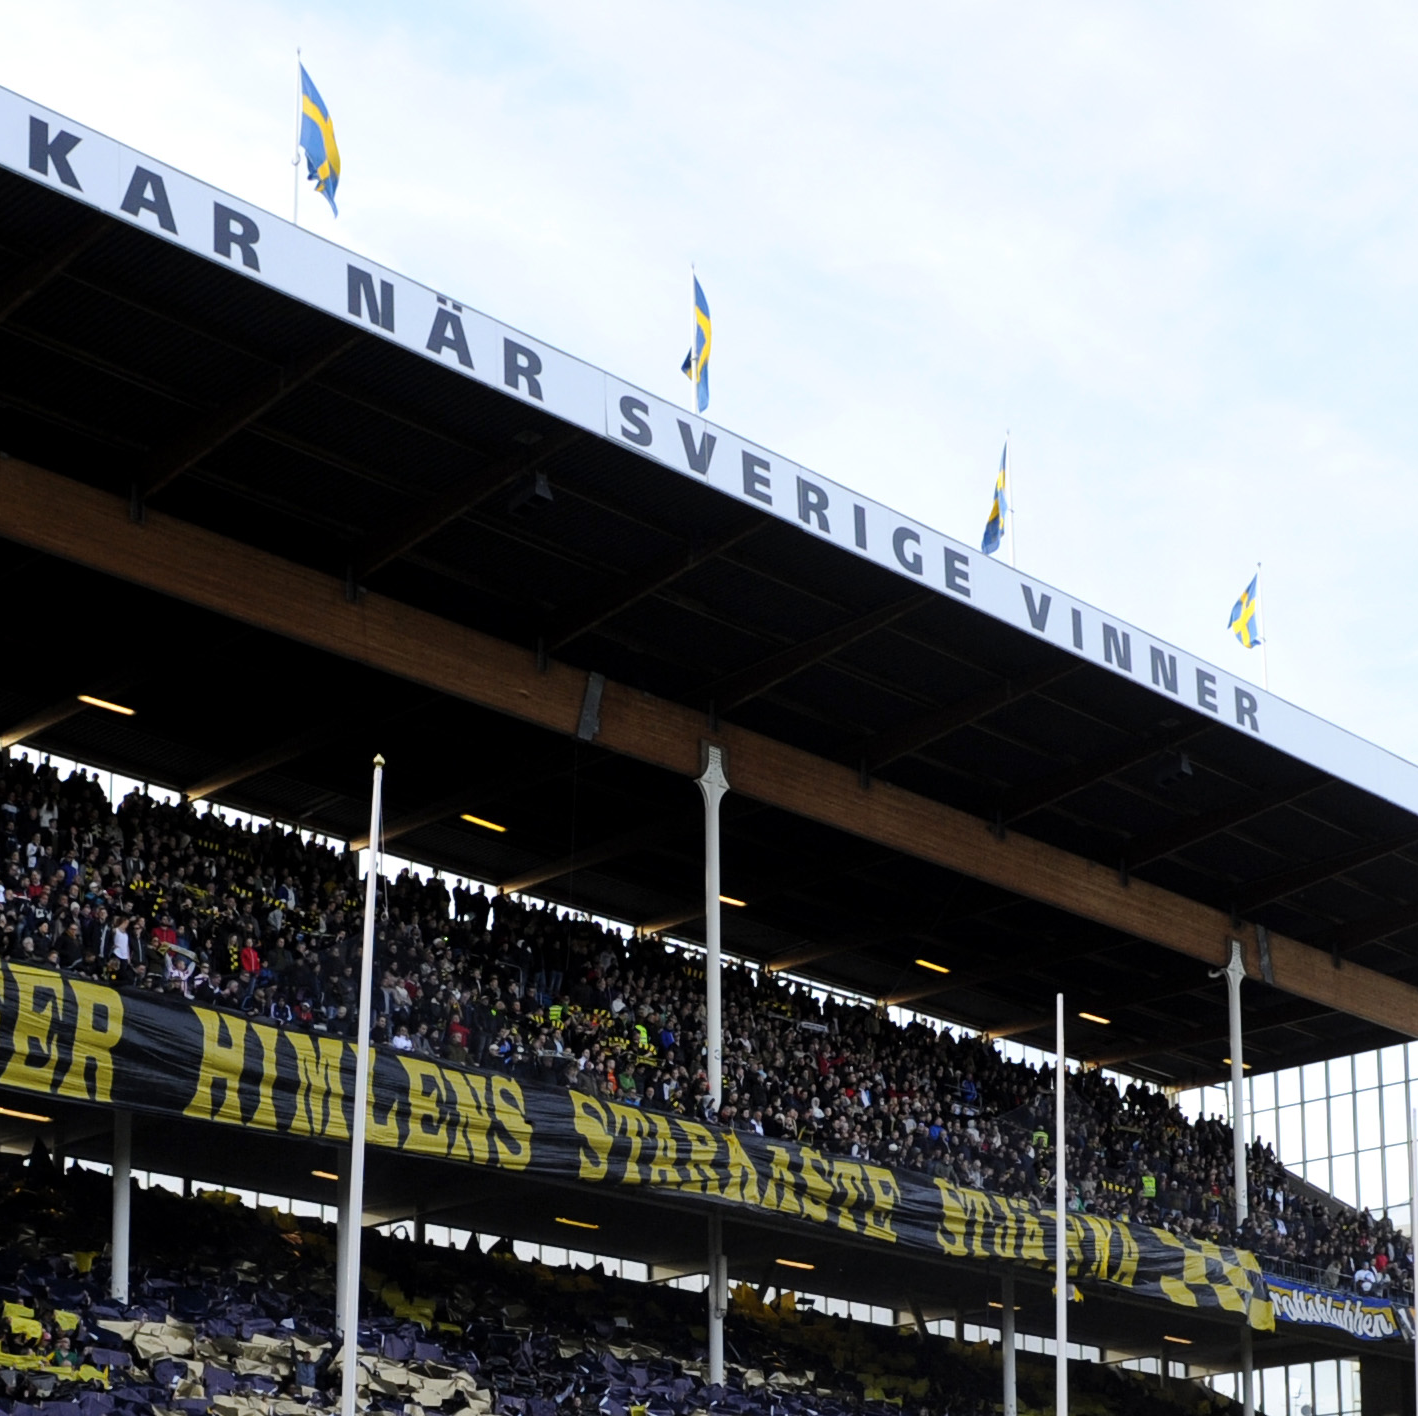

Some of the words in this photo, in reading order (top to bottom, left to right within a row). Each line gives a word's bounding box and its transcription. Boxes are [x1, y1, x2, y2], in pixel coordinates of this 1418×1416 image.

[347, 264, 543, 400] NÄR
[619, 394, 971, 597] SVERIGE
[1021, 582, 1259, 733] VINNER
